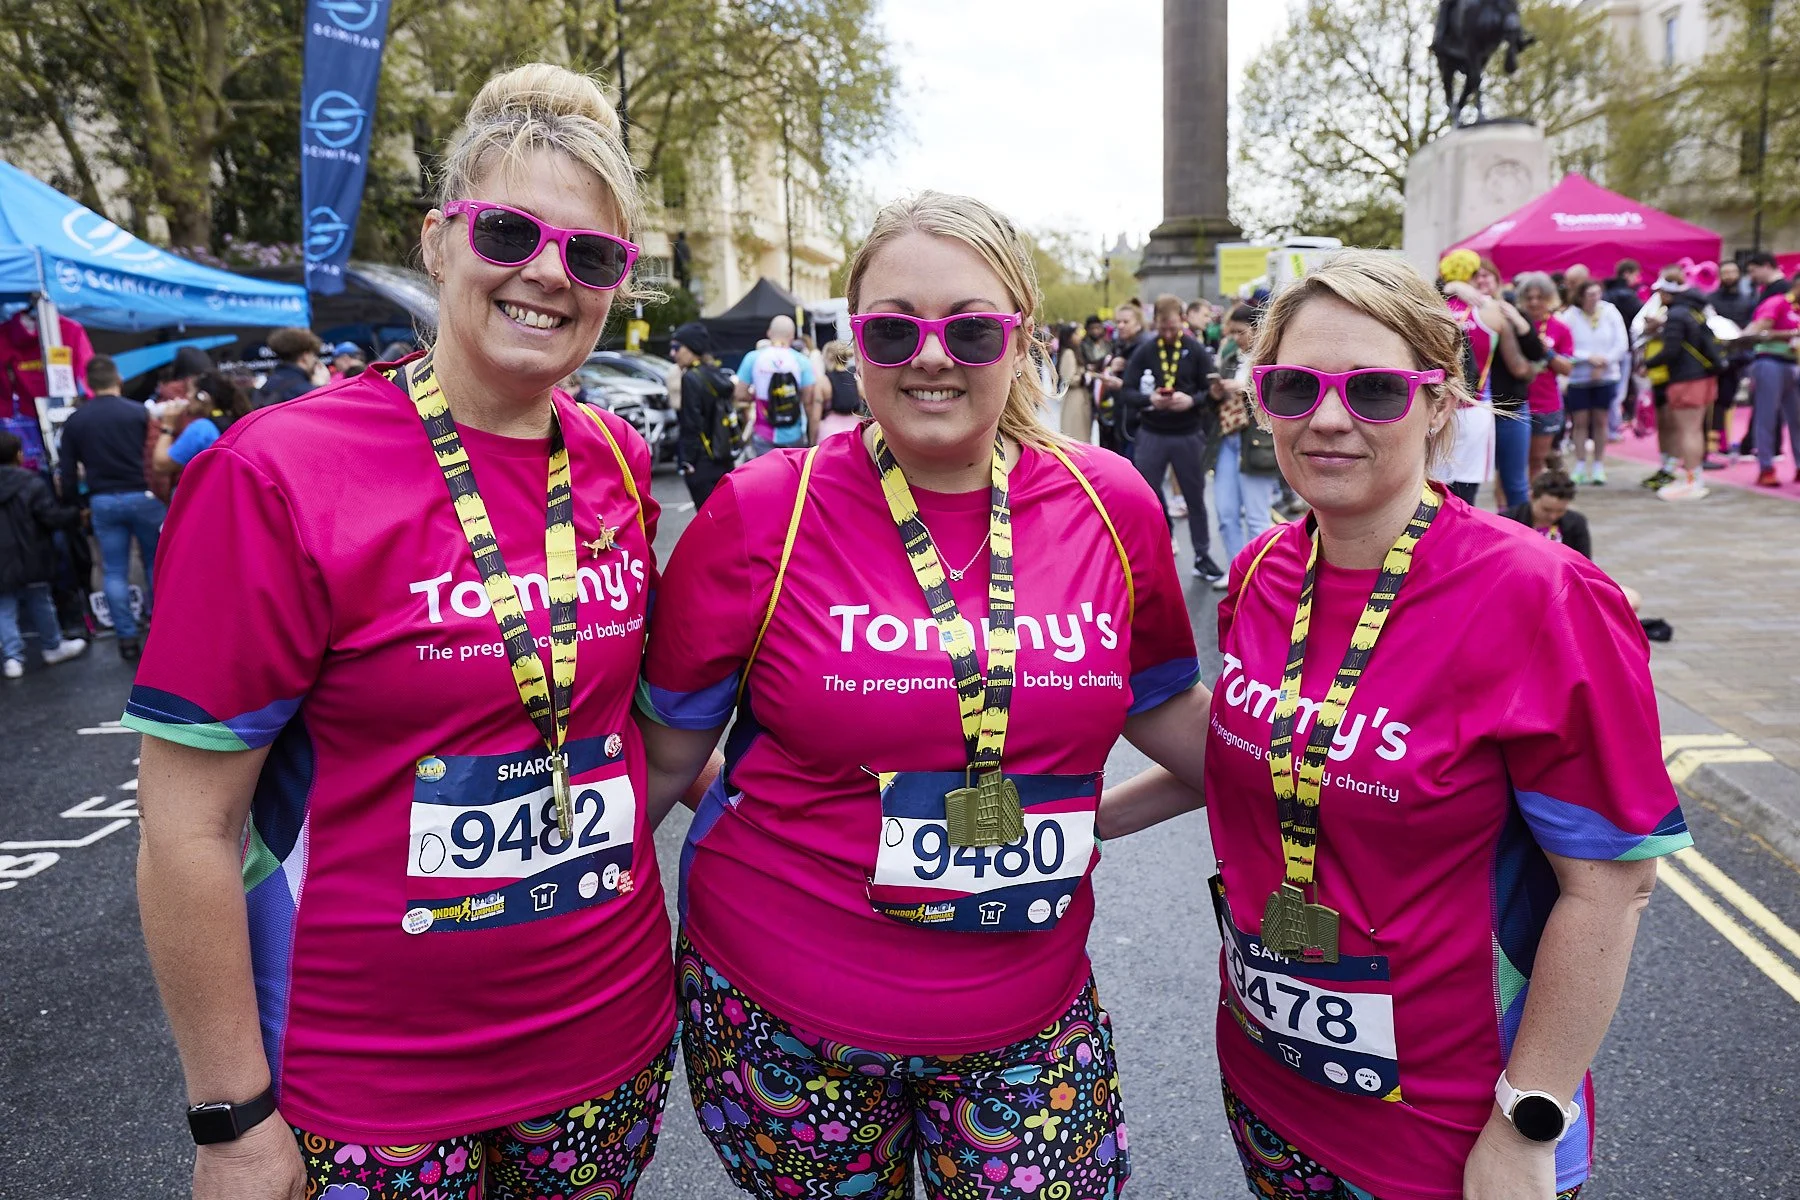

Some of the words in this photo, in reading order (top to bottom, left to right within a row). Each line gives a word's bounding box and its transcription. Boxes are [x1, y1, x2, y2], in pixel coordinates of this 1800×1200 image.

[313, 22, 380, 50] SCIMITAR
[1552, 212, 1643, 227] Tommy's
[84, 269, 185, 299] SCIMITAR
[432, 431, 459, 447] FINISHER
[444, 463, 470, 479] FINISHER
[905, 531, 928, 550] FINISHER
[474, 543, 499, 559] FINISHER
[409, 550, 645, 624] Tommy's
[1370, 592, 1396, 601] FINISHER
[931, 599, 956, 615] FINISHER
[502, 623, 529, 641] FINISHER
[552, 622, 577, 633] FINISHER
[829, 602, 1119, 663] Tommy's
[416, 644, 453, 661] The
[460, 631, 551, 664] pregc
[576, 626, 593, 642] nd
[596, 619, 626, 639] baby
[1337, 667, 1361, 677] FINISHER
[823, 674, 857, 692] The
[862, 673, 958, 696] pregnanc
[1023, 670, 1073, 691] baby
[1078, 670, 1123, 690] charity
[957, 672, 982, 689] FINISHER
[987, 678, 1013, 687] FINISHER
[1223, 652, 1411, 761] Tommy's
[1271, 735, 1292, 748] FINISHER
[1305, 744, 1329, 755] FINISHER
[1216, 724, 1263, 760] pregnancy
[1294, 755, 1331, 787] by
[1336, 773, 1400, 802] charity
[450, 788, 610, 870] 9482
[1280, 820, 1294, 829] FINIS
[1293, 824, 1316, 836] FINISHER
[912, 819, 1065, 881] 9480
[608, 875, 615, 885] 4
[407, 910, 423, 919] Run
[431, 904, 462, 919] ONDON
[471, 902, 505, 918] LANDMARKS
[885, 908, 917, 918] LONDON
[923, 911, 955, 921] LANDMARKS
[986, 910, 996, 920] XL
[408, 919, 428, 929] Sleep
[411, 923, 429, 933] Repeat
[1249, 943, 1290, 965] SAM
[1232, 948, 1357, 1044] 9478
[1358, 1072, 1377, 1081] WAVE
[1364, 1079, 1373, 1088] 4
